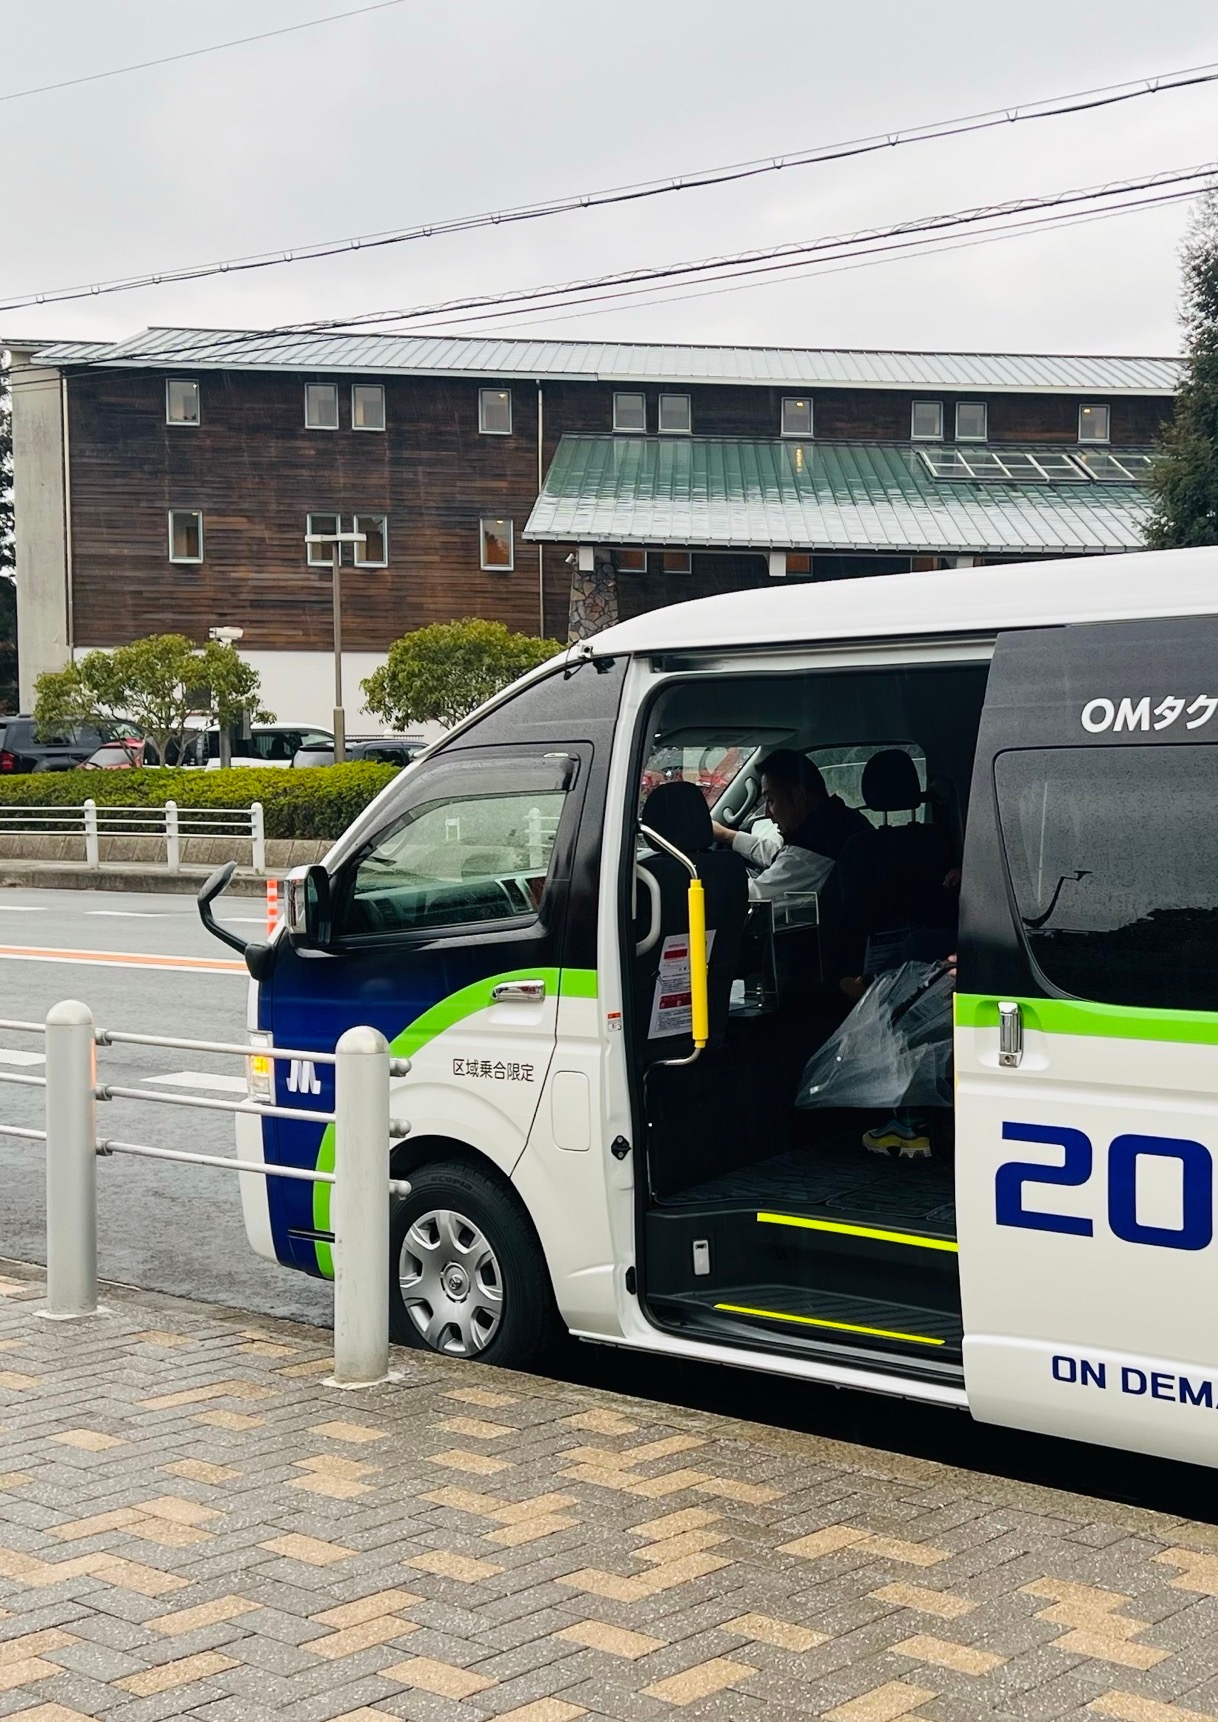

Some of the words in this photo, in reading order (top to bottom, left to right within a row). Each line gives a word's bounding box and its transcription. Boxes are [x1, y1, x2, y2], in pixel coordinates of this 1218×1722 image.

[453, 1058, 535, 1083] 区域乗合限定
[1051, 1354, 1106, 1389] ON
